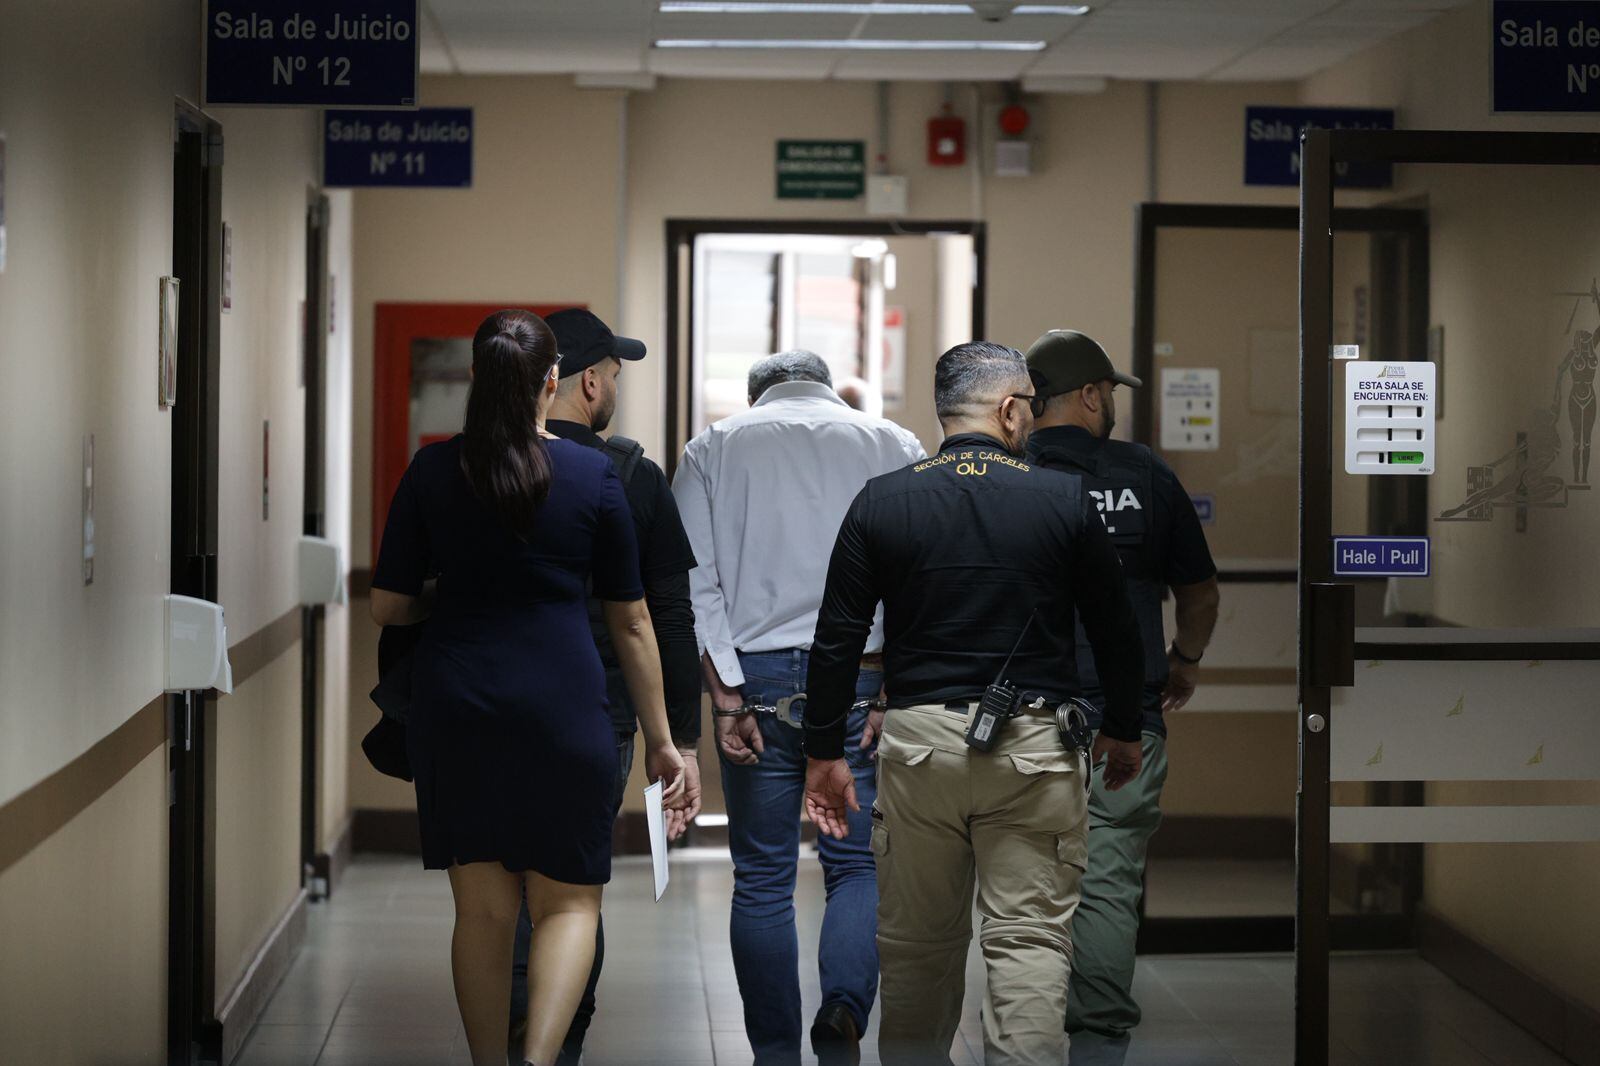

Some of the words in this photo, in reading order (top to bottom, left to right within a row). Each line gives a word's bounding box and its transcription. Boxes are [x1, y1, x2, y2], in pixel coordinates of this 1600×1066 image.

[214, 11, 274, 39] Sala
[283, 12, 317, 39] de
[325, 13, 410, 40] Juicio
[1500, 19, 1559, 47] Sala
[1567, 20, 1600, 47] de
[317, 56, 351, 86] 12
[328, 120, 372, 143] Sala
[377, 121, 402, 143] de
[407, 121, 470, 143] Juicio
[1249, 119, 1294, 142] Sala
[402, 151, 426, 175] 11
[1353, 392, 1411, 401] ENCUENTRA
[1412, 392, 1429, 401] EN:
[1359, 381, 1383, 390] ESTA
[1384, 381, 1410, 390] SALA
[1411, 382, 1424, 390] SE
[960, 451, 974, 460] DE
[1343, 549, 1377, 565] Hale
[1390, 549, 1419, 565] Pull
